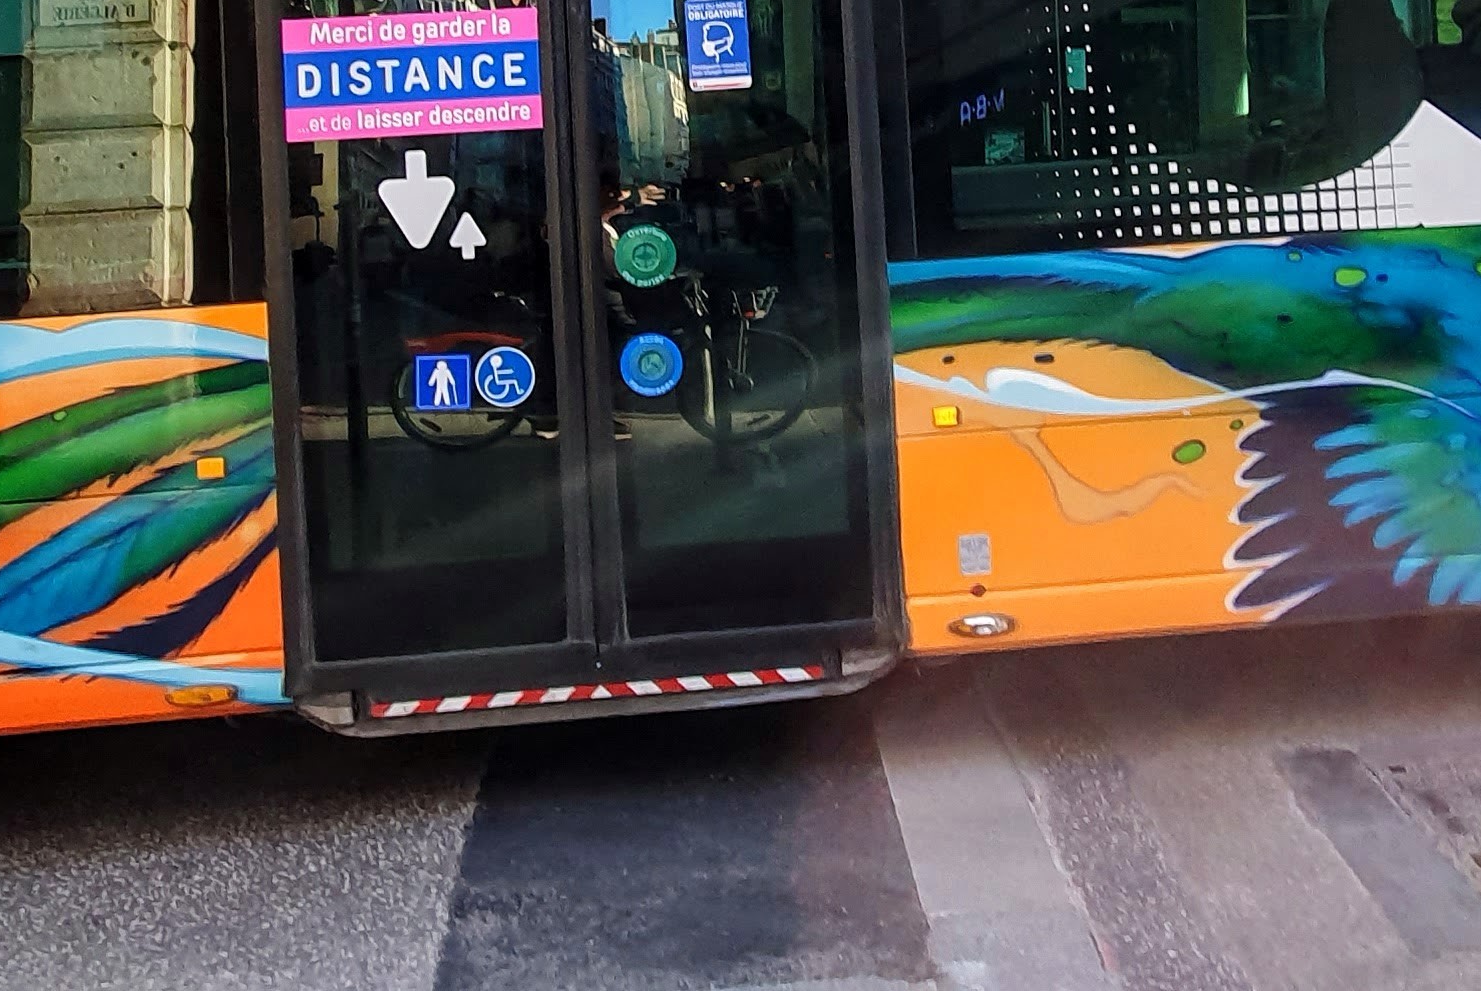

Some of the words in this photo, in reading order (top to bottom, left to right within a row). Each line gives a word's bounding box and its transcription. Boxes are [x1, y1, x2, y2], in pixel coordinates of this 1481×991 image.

[310, 21, 373, 45] Merci
[379, 18, 406, 42] de
[411, 16, 487, 45] garder
[490, 13, 511, 36] la
[688, 8, 745, 21] OBLIGATOIRE
[296, 52, 527, 99] DISTANCE
[330, 113, 352, 132] de
[357, 108, 421, 130] laisser
[428, 101, 531, 126] descendre
